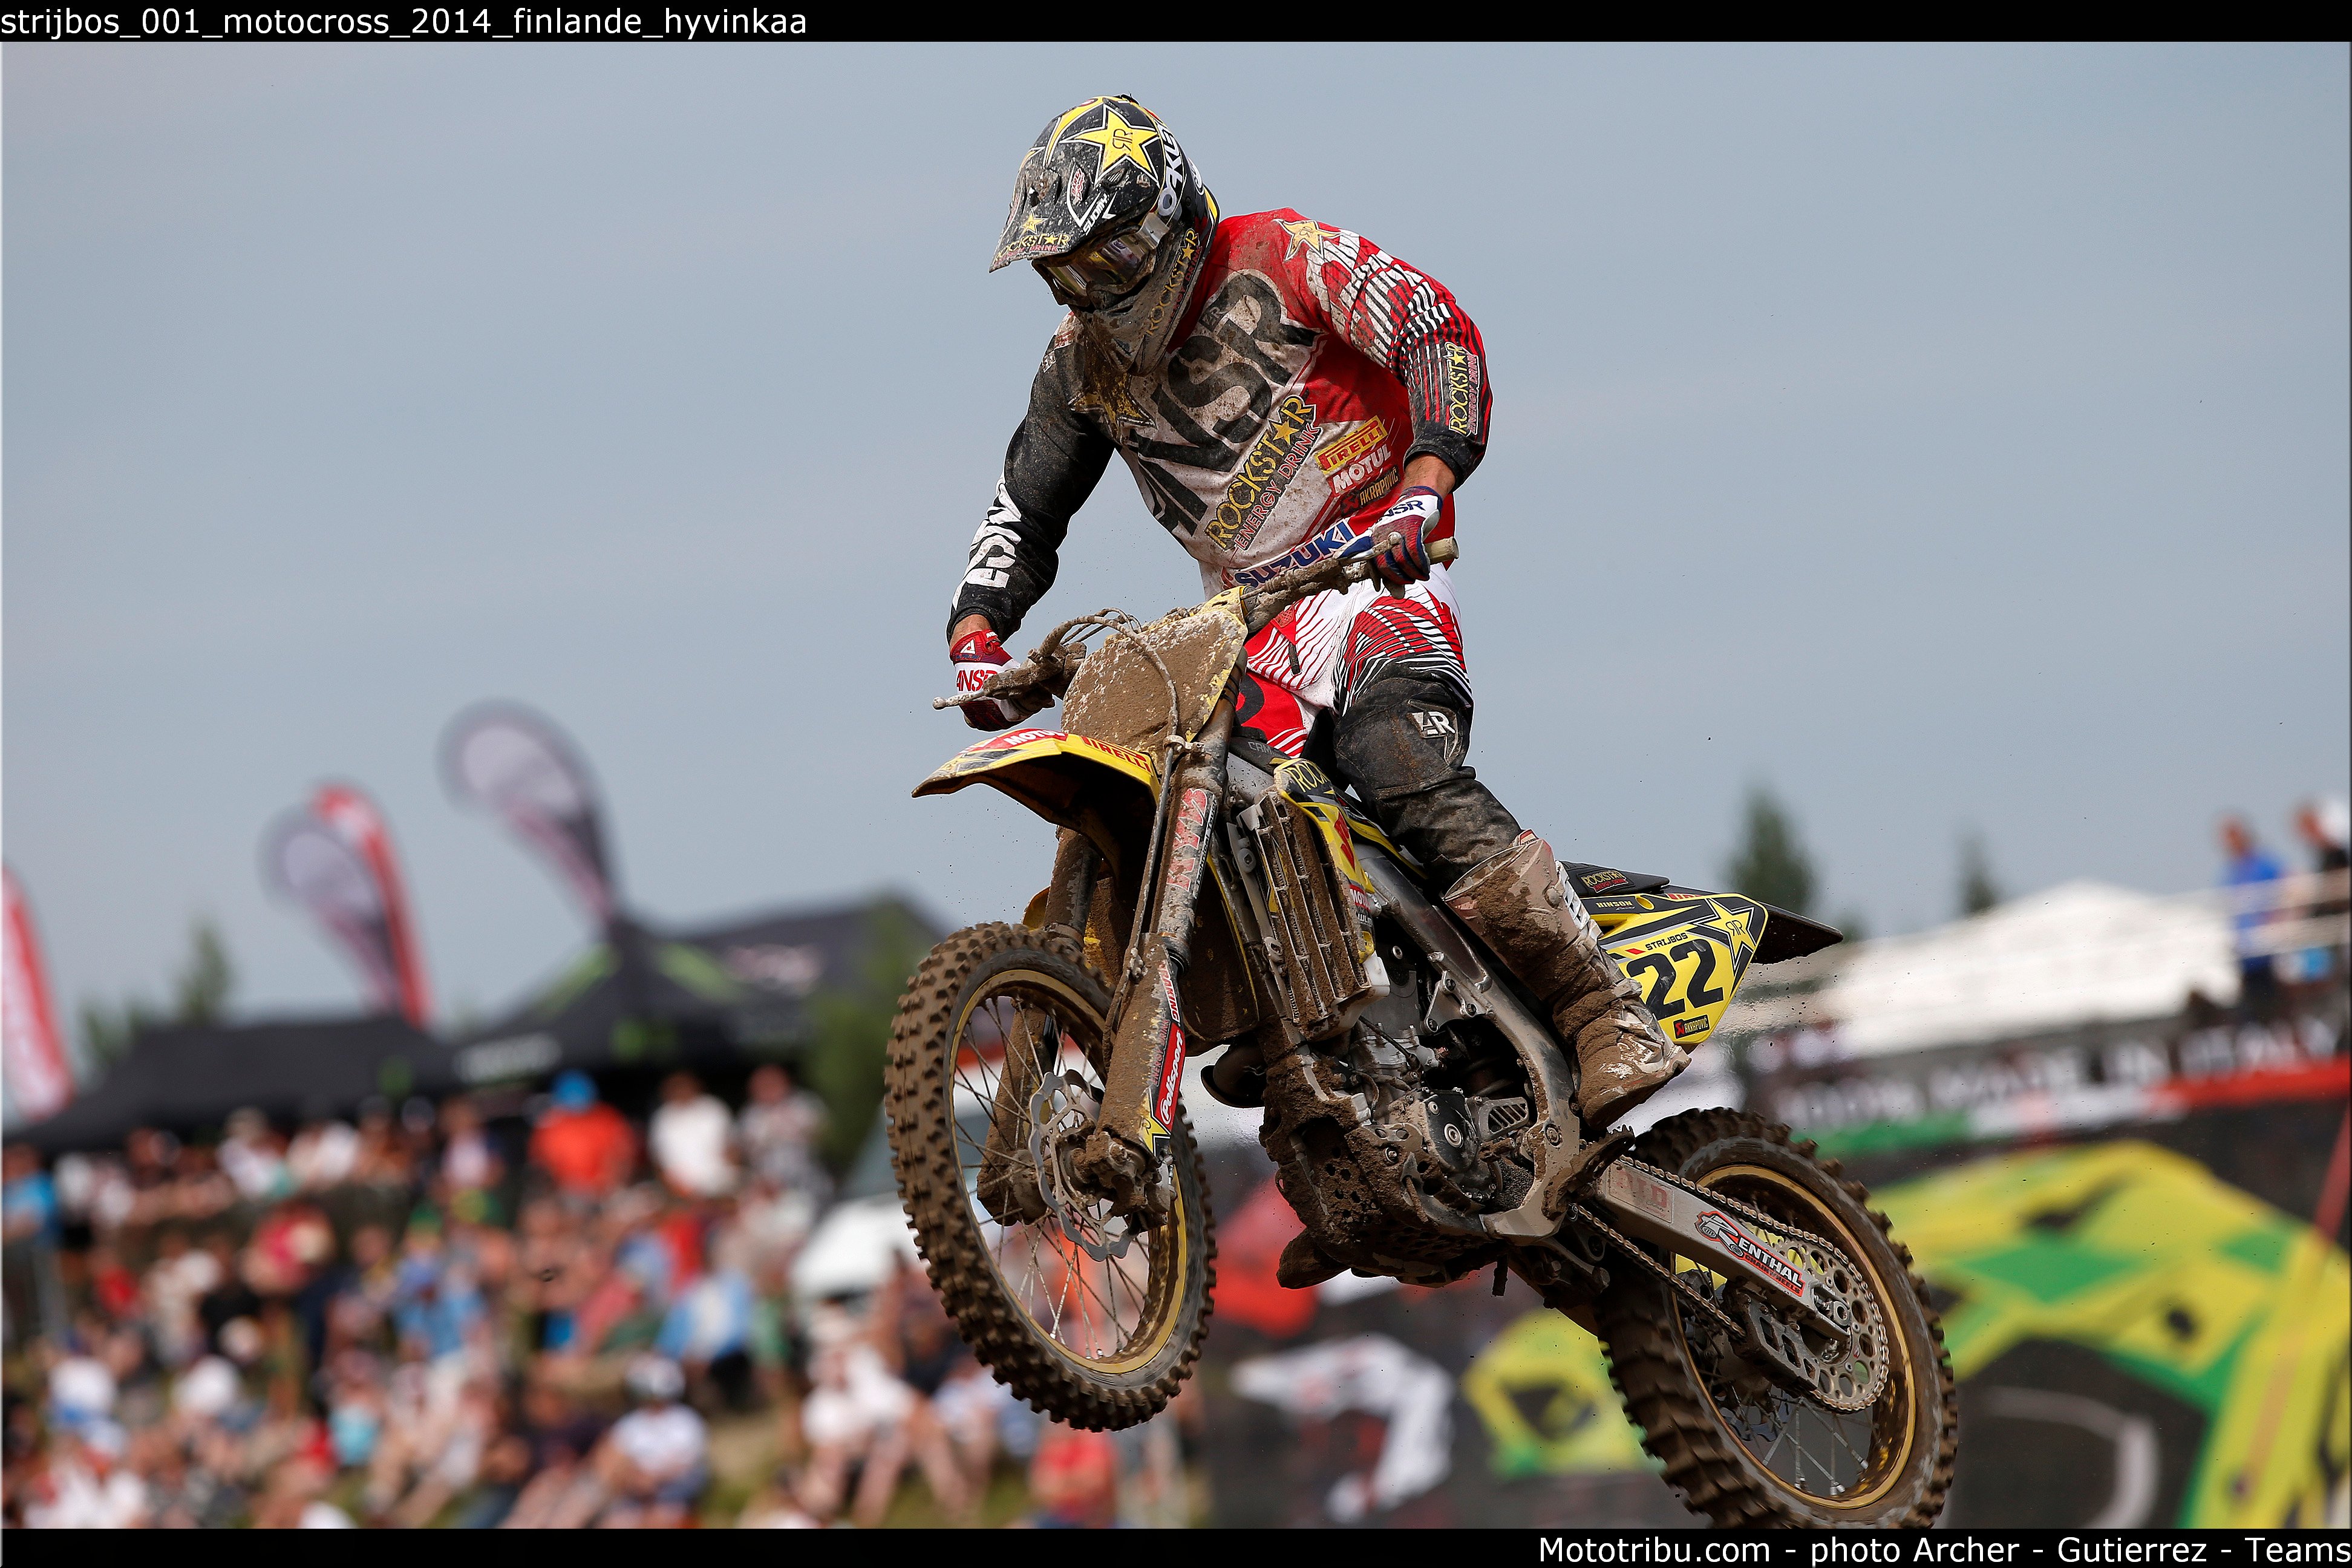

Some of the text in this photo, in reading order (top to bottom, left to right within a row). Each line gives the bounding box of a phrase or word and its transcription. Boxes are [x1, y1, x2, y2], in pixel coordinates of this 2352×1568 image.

[1445, 342, 1468, 435] ROCKSTAR
[1206, 397, 1313, 549] ROCKSTAR
[1317, 419, 1384, 470] PIRELLI
[1332, 443, 1392, 494] MOTUL
[1234, 421, 1321, 550] ENERGY DRINK
[1235, 520, 1356, 589] SUZUKI
[1080, 735, 1152, 774] PIRELLI
[1596, 900, 1633, 908] HINSON
[1645, 932, 1688, 951] STRIJBOS
[1626, 938, 1724, 1021] 22
[1160, 1030, 1183, 1125] Polisport
[1698, 1214, 1803, 1289] RENTHAL
